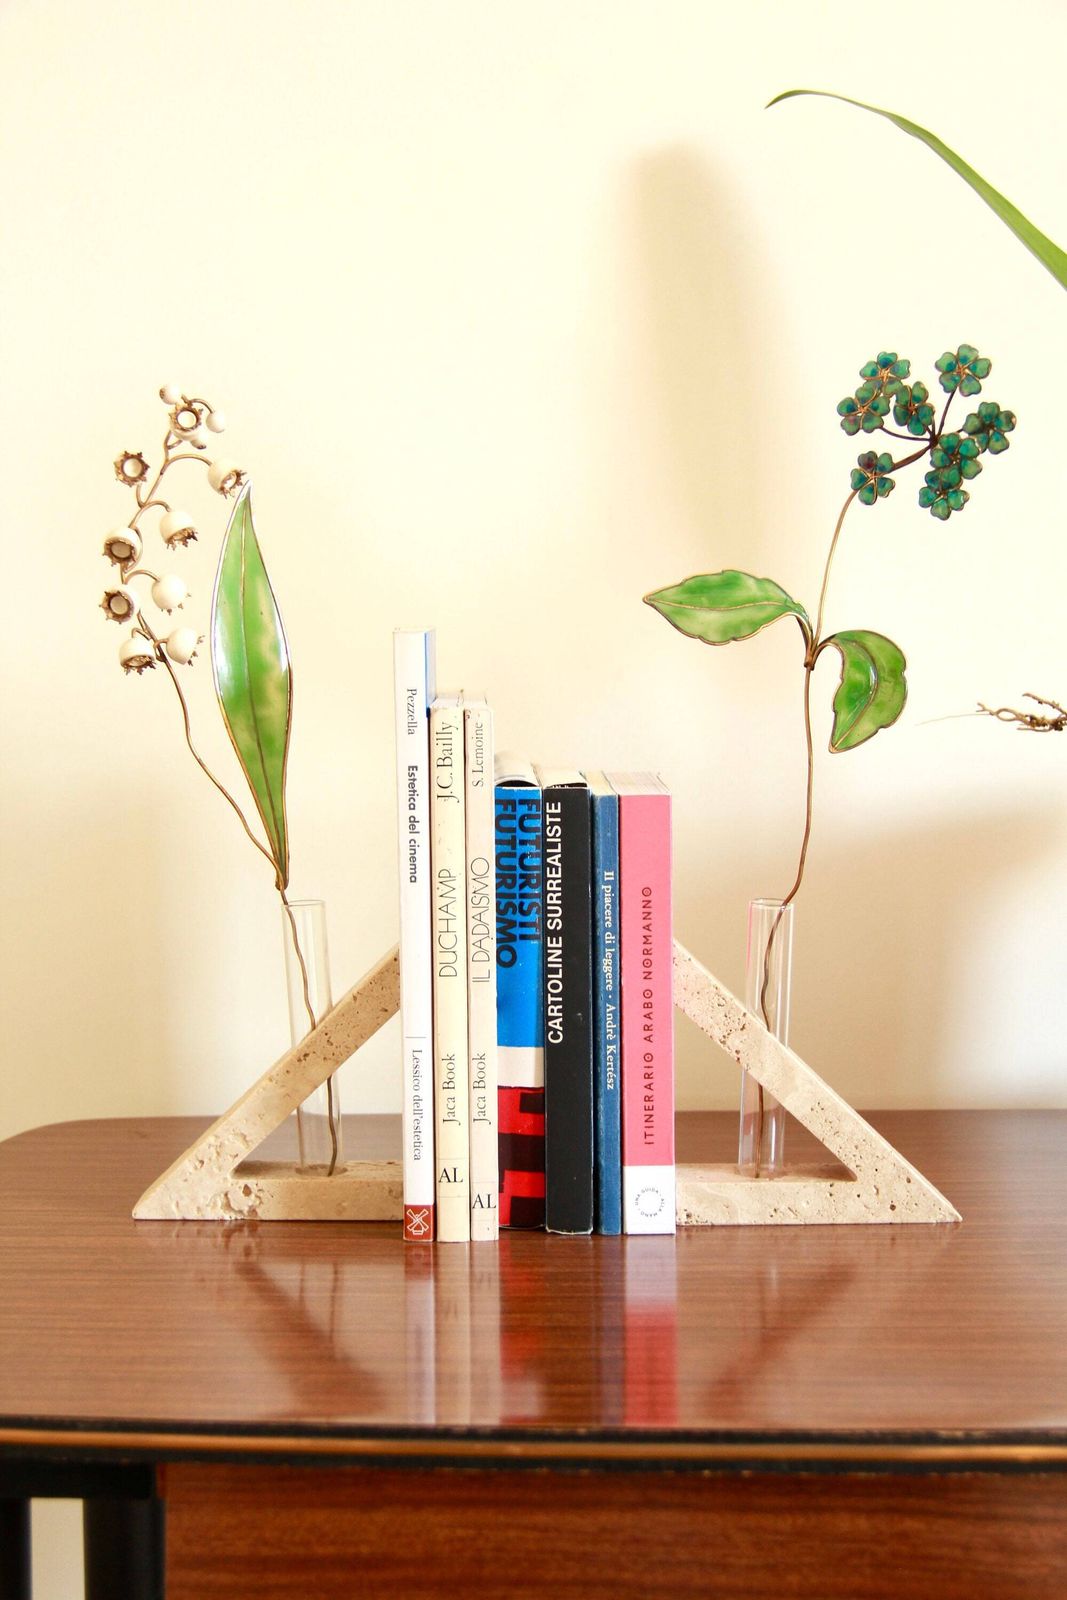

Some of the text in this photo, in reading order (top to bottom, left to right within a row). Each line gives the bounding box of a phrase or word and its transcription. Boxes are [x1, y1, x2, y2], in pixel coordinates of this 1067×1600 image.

[407, 688, 418, 735] Pezzella
[436, 721, 459, 769] Bailly
[472, 722, 484, 787] S. Lemoine
[408, 765, 420, 883] Estetica del cinema
[495, 798, 518, 968] FUTURISMO
[518, 798, 542, 941] FUTURISTI
[546, 801, 562, 931] SURREALISTE
[604, 871, 615, 881] Il
[438, 868, 458, 977] DUCHAMP
[470, 857, 490, 983] IL DADAISMO
[602, 885, 615, 928] piacere
[604, 931, 616, 944] di
[547, 936, 563, 1044] CARTOLINE
[603, 948, 616, 991] leggere
[641, 886, 654, 1145] ITINERARIO ARABO NORMANNO
[441, 1053, 461, 1126] Jaca Book
[472, 1052, 492, 1125] Jaca Book
[606, 1044, 618, 1090] Kertész
[412, 1050, 424, 1161] Lessico dell'estetica
[438, 1167, 464, 1183] AL
[472, 1193, 497, 1209] AL
